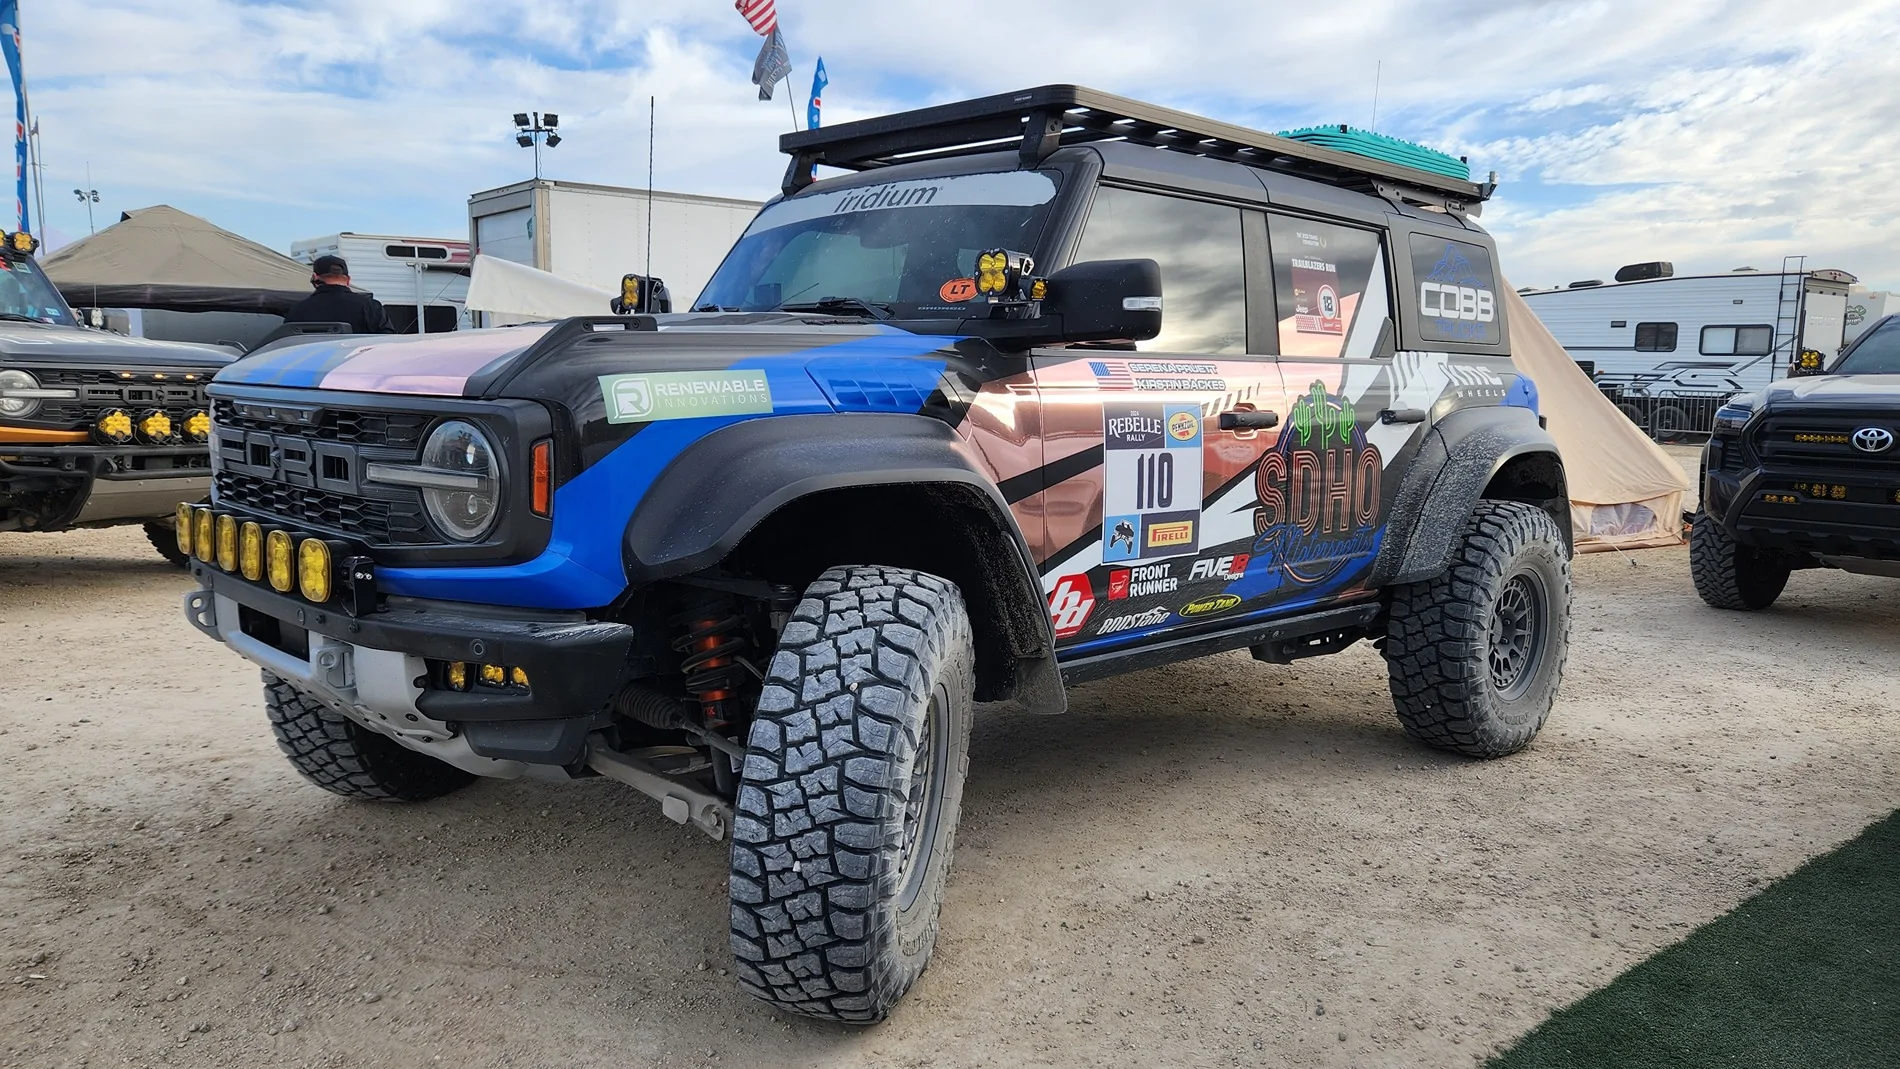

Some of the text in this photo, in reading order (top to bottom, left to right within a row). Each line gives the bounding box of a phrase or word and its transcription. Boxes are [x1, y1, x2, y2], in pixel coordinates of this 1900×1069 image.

[834, 185, 938, 214] iridium
[1292, 258, 1326, 272] TRAILBLAZERS
[1325, 262, 1337, 273] RUN
[949, 284, 971, 295] LT
[1295, 304, 1309, 315] Jeep
[1421, 281, 1494, 323] COBB
[1434, 319, 1489, 339] TRUCKS
[1129, 362, 1218, 375] SERENA PRUETT
[654, 379, 766, 397] RENEWABLE
[1136, 378, 1226, 392] KIRSTIN BACKES
[1457, 389, 1506, 398] WHEELS
[656, 393, 768, 409] INNOVATIONS
[1108, 417, 1162, 438] REBELLE
[1171, 419, 1196, 432] PENNZOIL
[1126, 433, 1146, 442] RALLY
[218, 424, 358, 496] FORD
[1136, 452, 1174, 510] 110
[1152, 525, 1189, 542] PIRELLI
[1254, 522, 1375, 575] Motorsports
[1131, 563, 1171, 582] FRONT
[1224, 572, 1245, 581] Designs
[1129, 578, 1178, 598] RUNNER
[1185, 597, 1238, 615] POWER TANK
